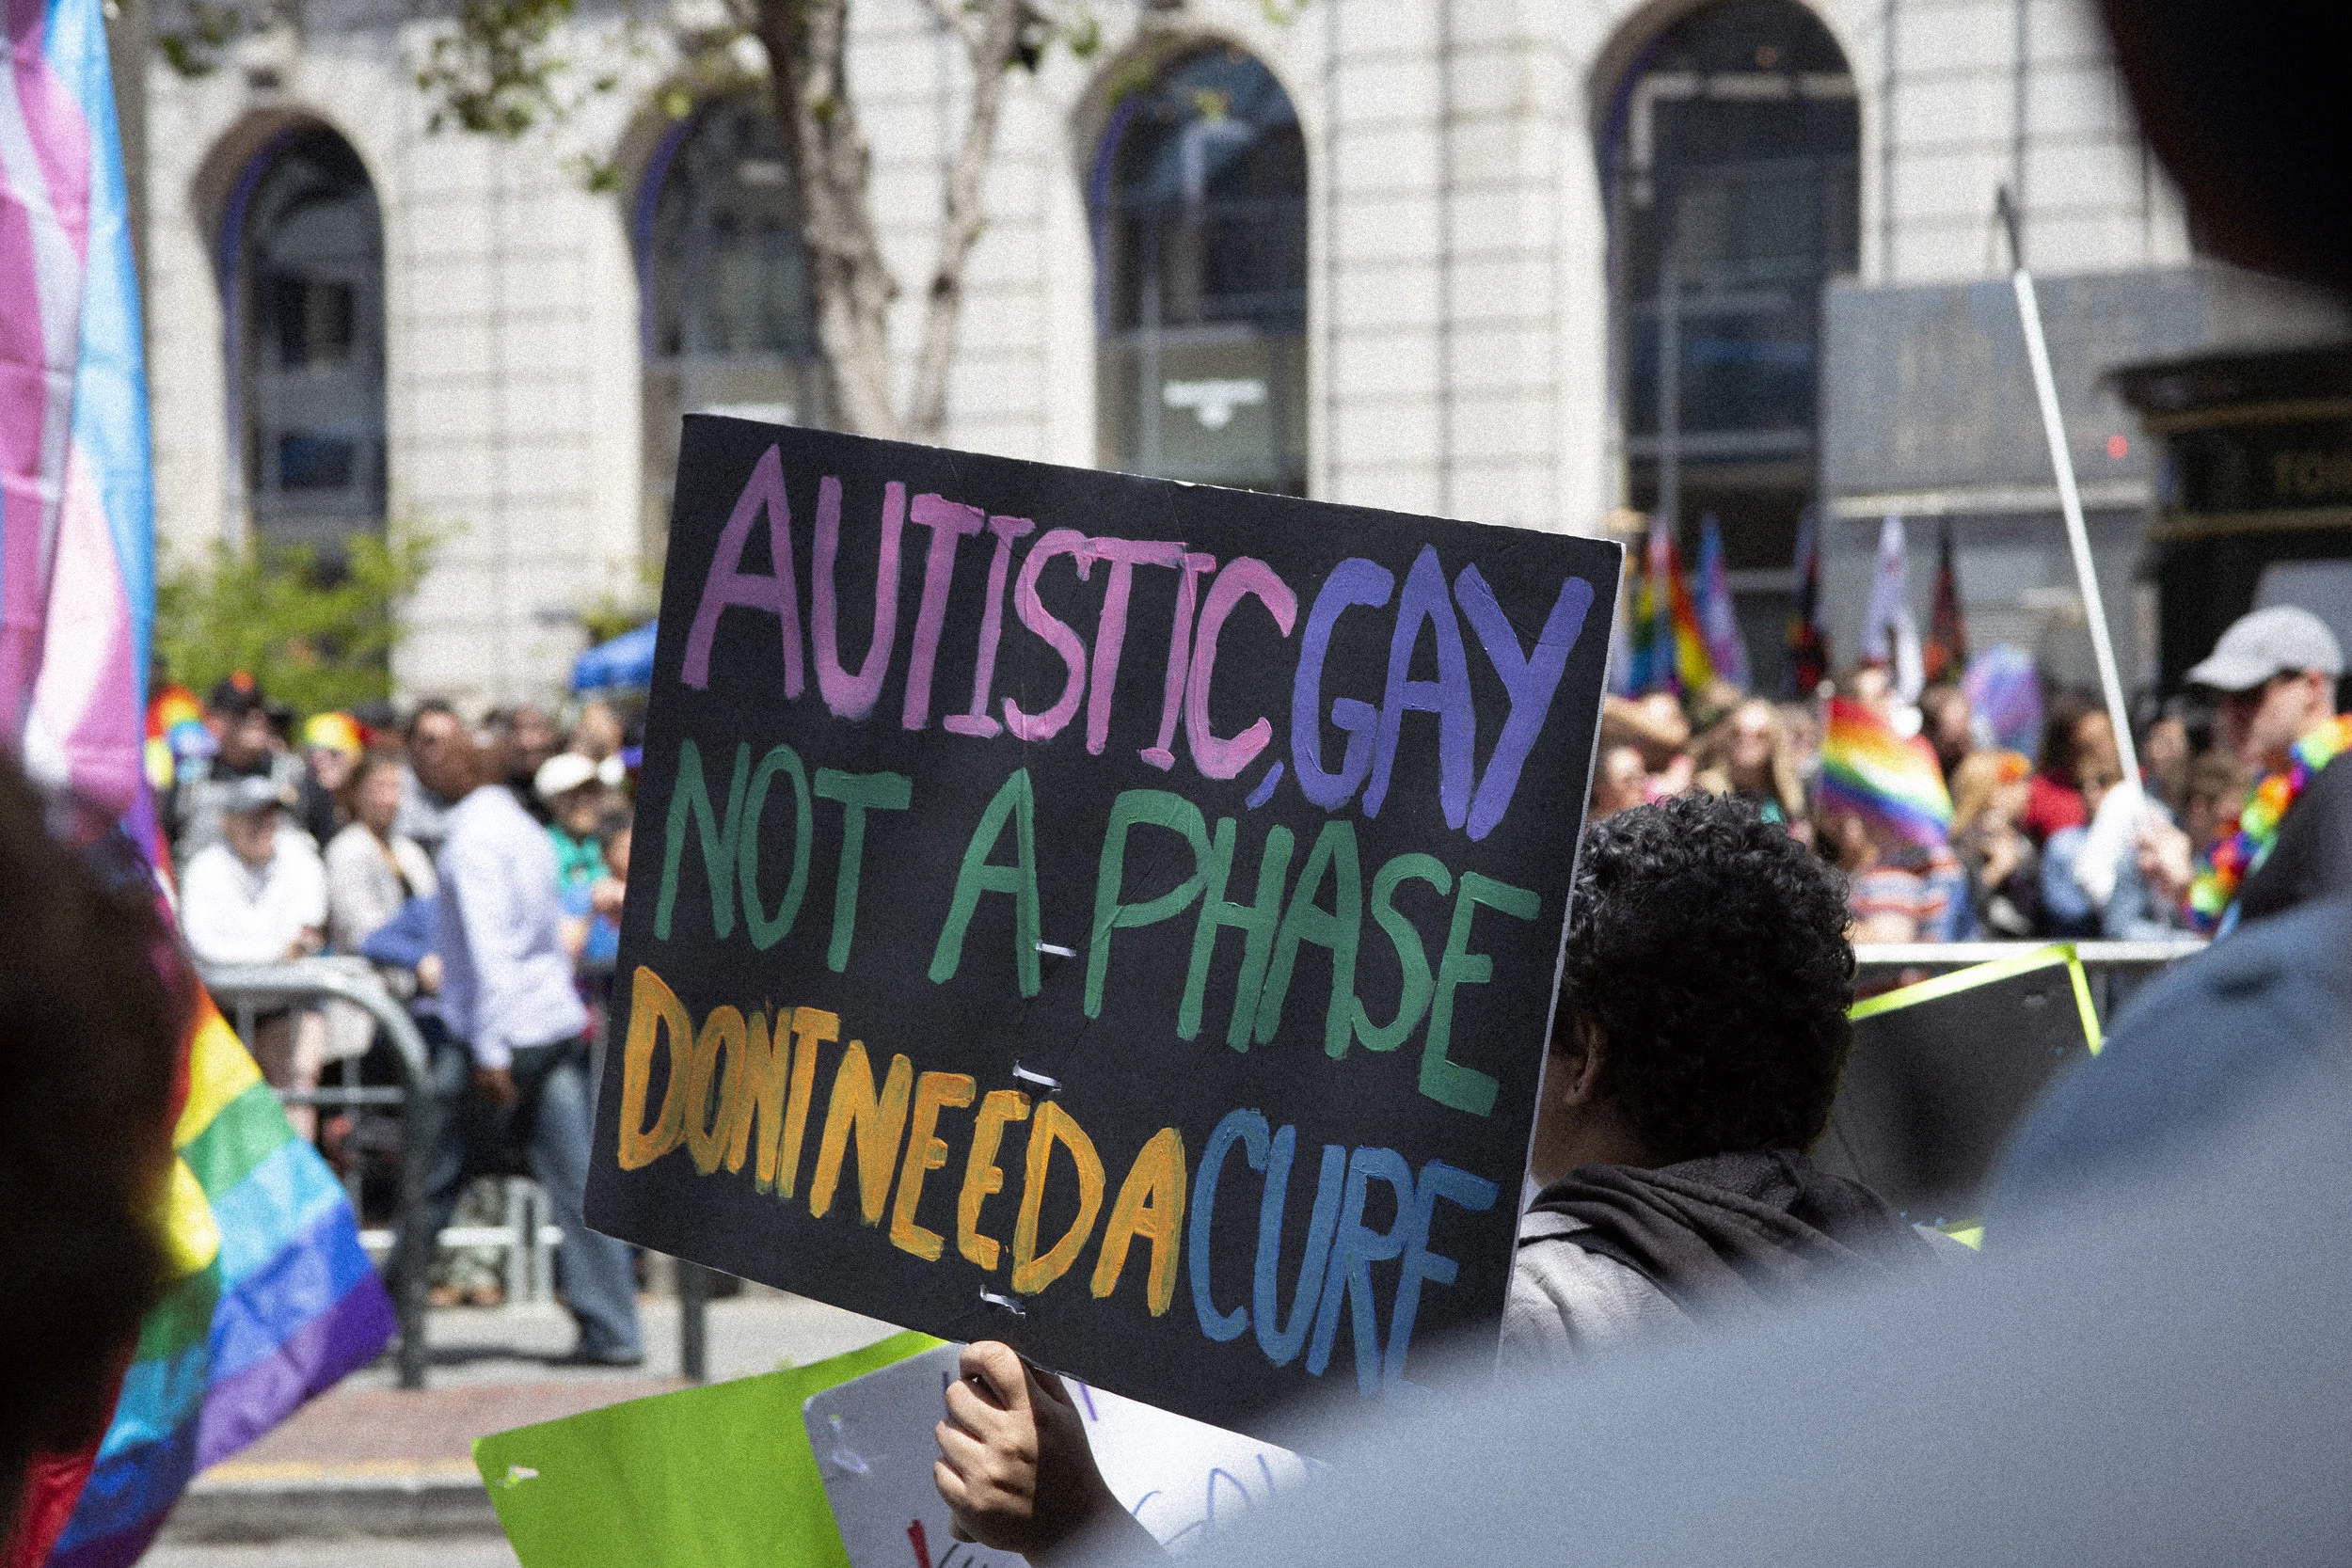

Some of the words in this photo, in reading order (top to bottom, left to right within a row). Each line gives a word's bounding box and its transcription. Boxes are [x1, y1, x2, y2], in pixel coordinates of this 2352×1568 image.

[1289, 545, 1596, 844] GAY
[654, 738, 912, 974] NOT
[928, 768, 1042, 997] A
[1082, 788, 1541, 1117] PHASE
[807, 1038, 1106, 1295] NEED
[1089, 1125, 1189, 1317] A
